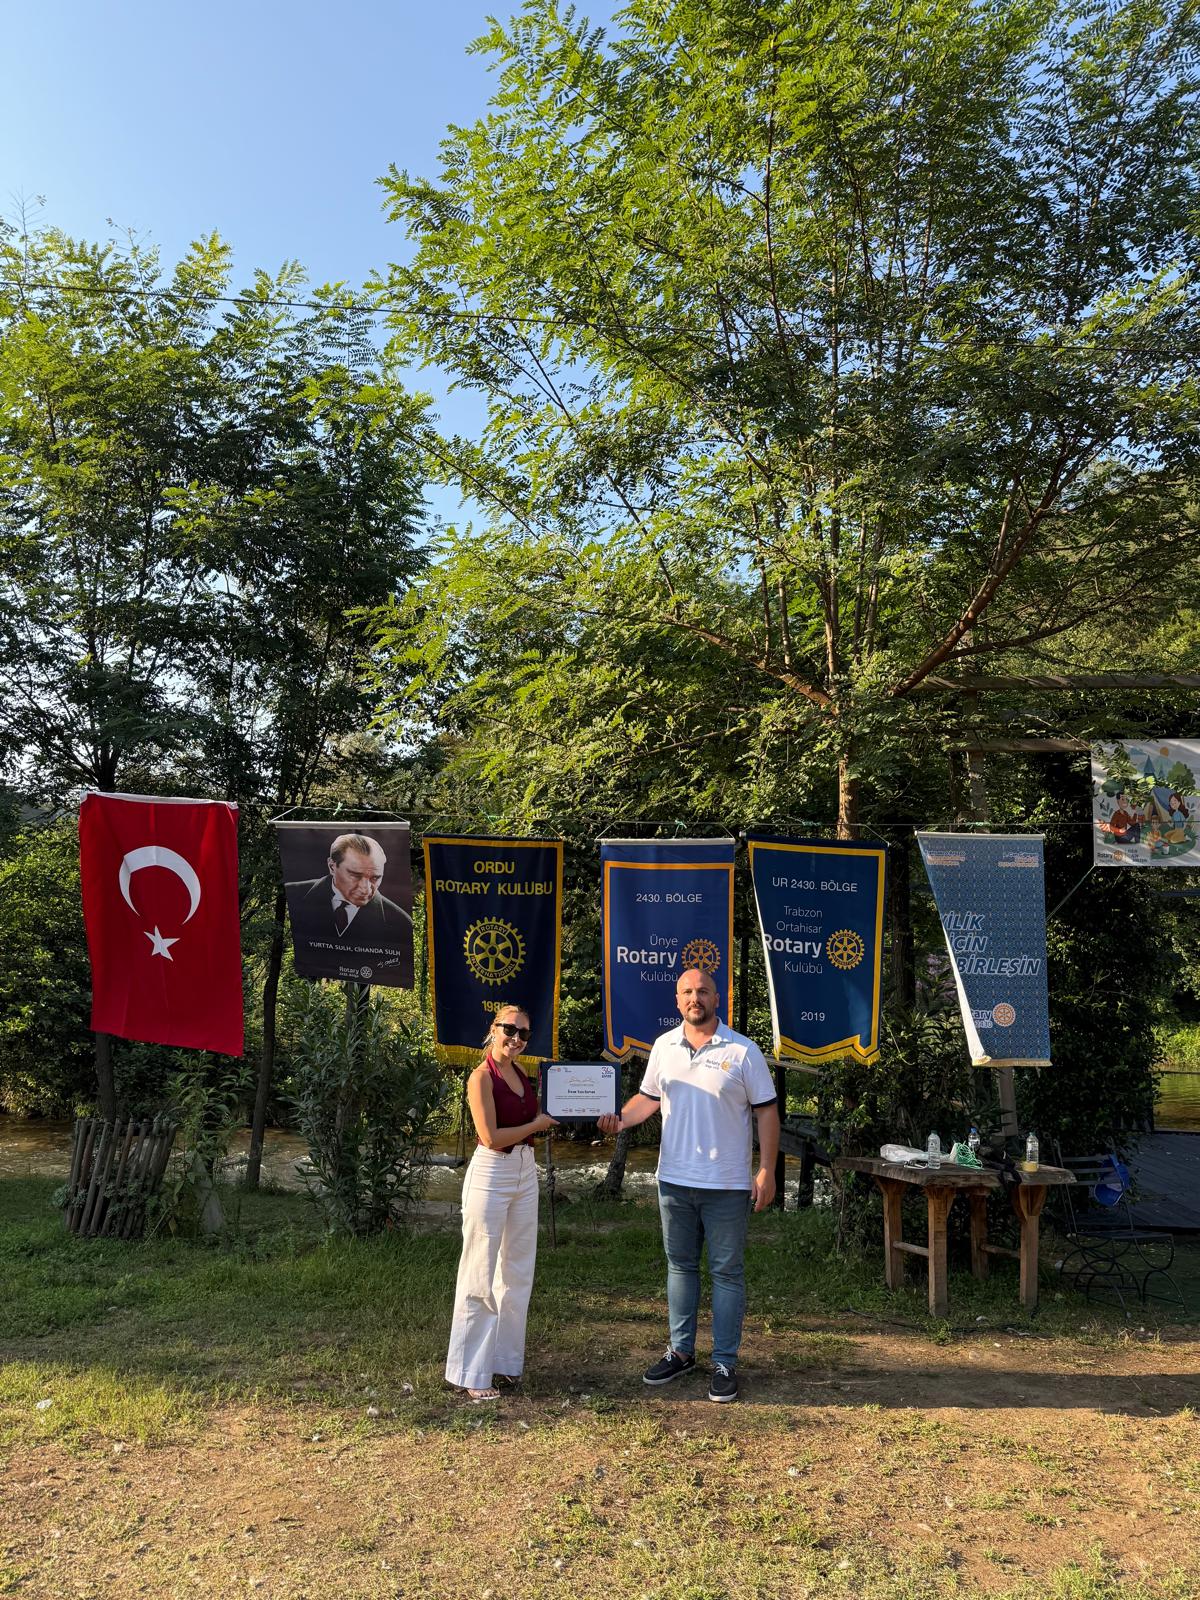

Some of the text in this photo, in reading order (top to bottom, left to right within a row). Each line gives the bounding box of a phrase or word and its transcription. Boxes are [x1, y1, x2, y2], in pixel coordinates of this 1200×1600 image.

[473, 861, 515, 874] ORDU
[435, 881, 491, 894] ROTARY
[772, 877, 858, 892] UR 2430. BÖLGE
[636, 892, 703, 903] 2430. BÖLGE
[783, 905, 823, 918] Trabzon
[480, 924, 507, 934] ROTARY
[776, 920, 823, 934] Ortahisar
[650, 934, 678, 949] Ünye
[764, 933, 822, 958] Rotary
[308, 942, 334, 950] YURTTA
[384, 948, 401, 956] SULH
[617, 946, 678, 970] Rotary
[339, 966, 360, 975] Rotary
[470, 956, 516, 978] INTERNATIONAL
[784, 961, 823, 974] Kulübü
[956, 954, 1042, 978] BİRLEŞİN
[640, 970, 678, 982] Kulübü
[481, 1000, 508, 1013] 198
[658, 1017, 681, 1027] 1988
[801, 1011, 826, 1022] 2019
